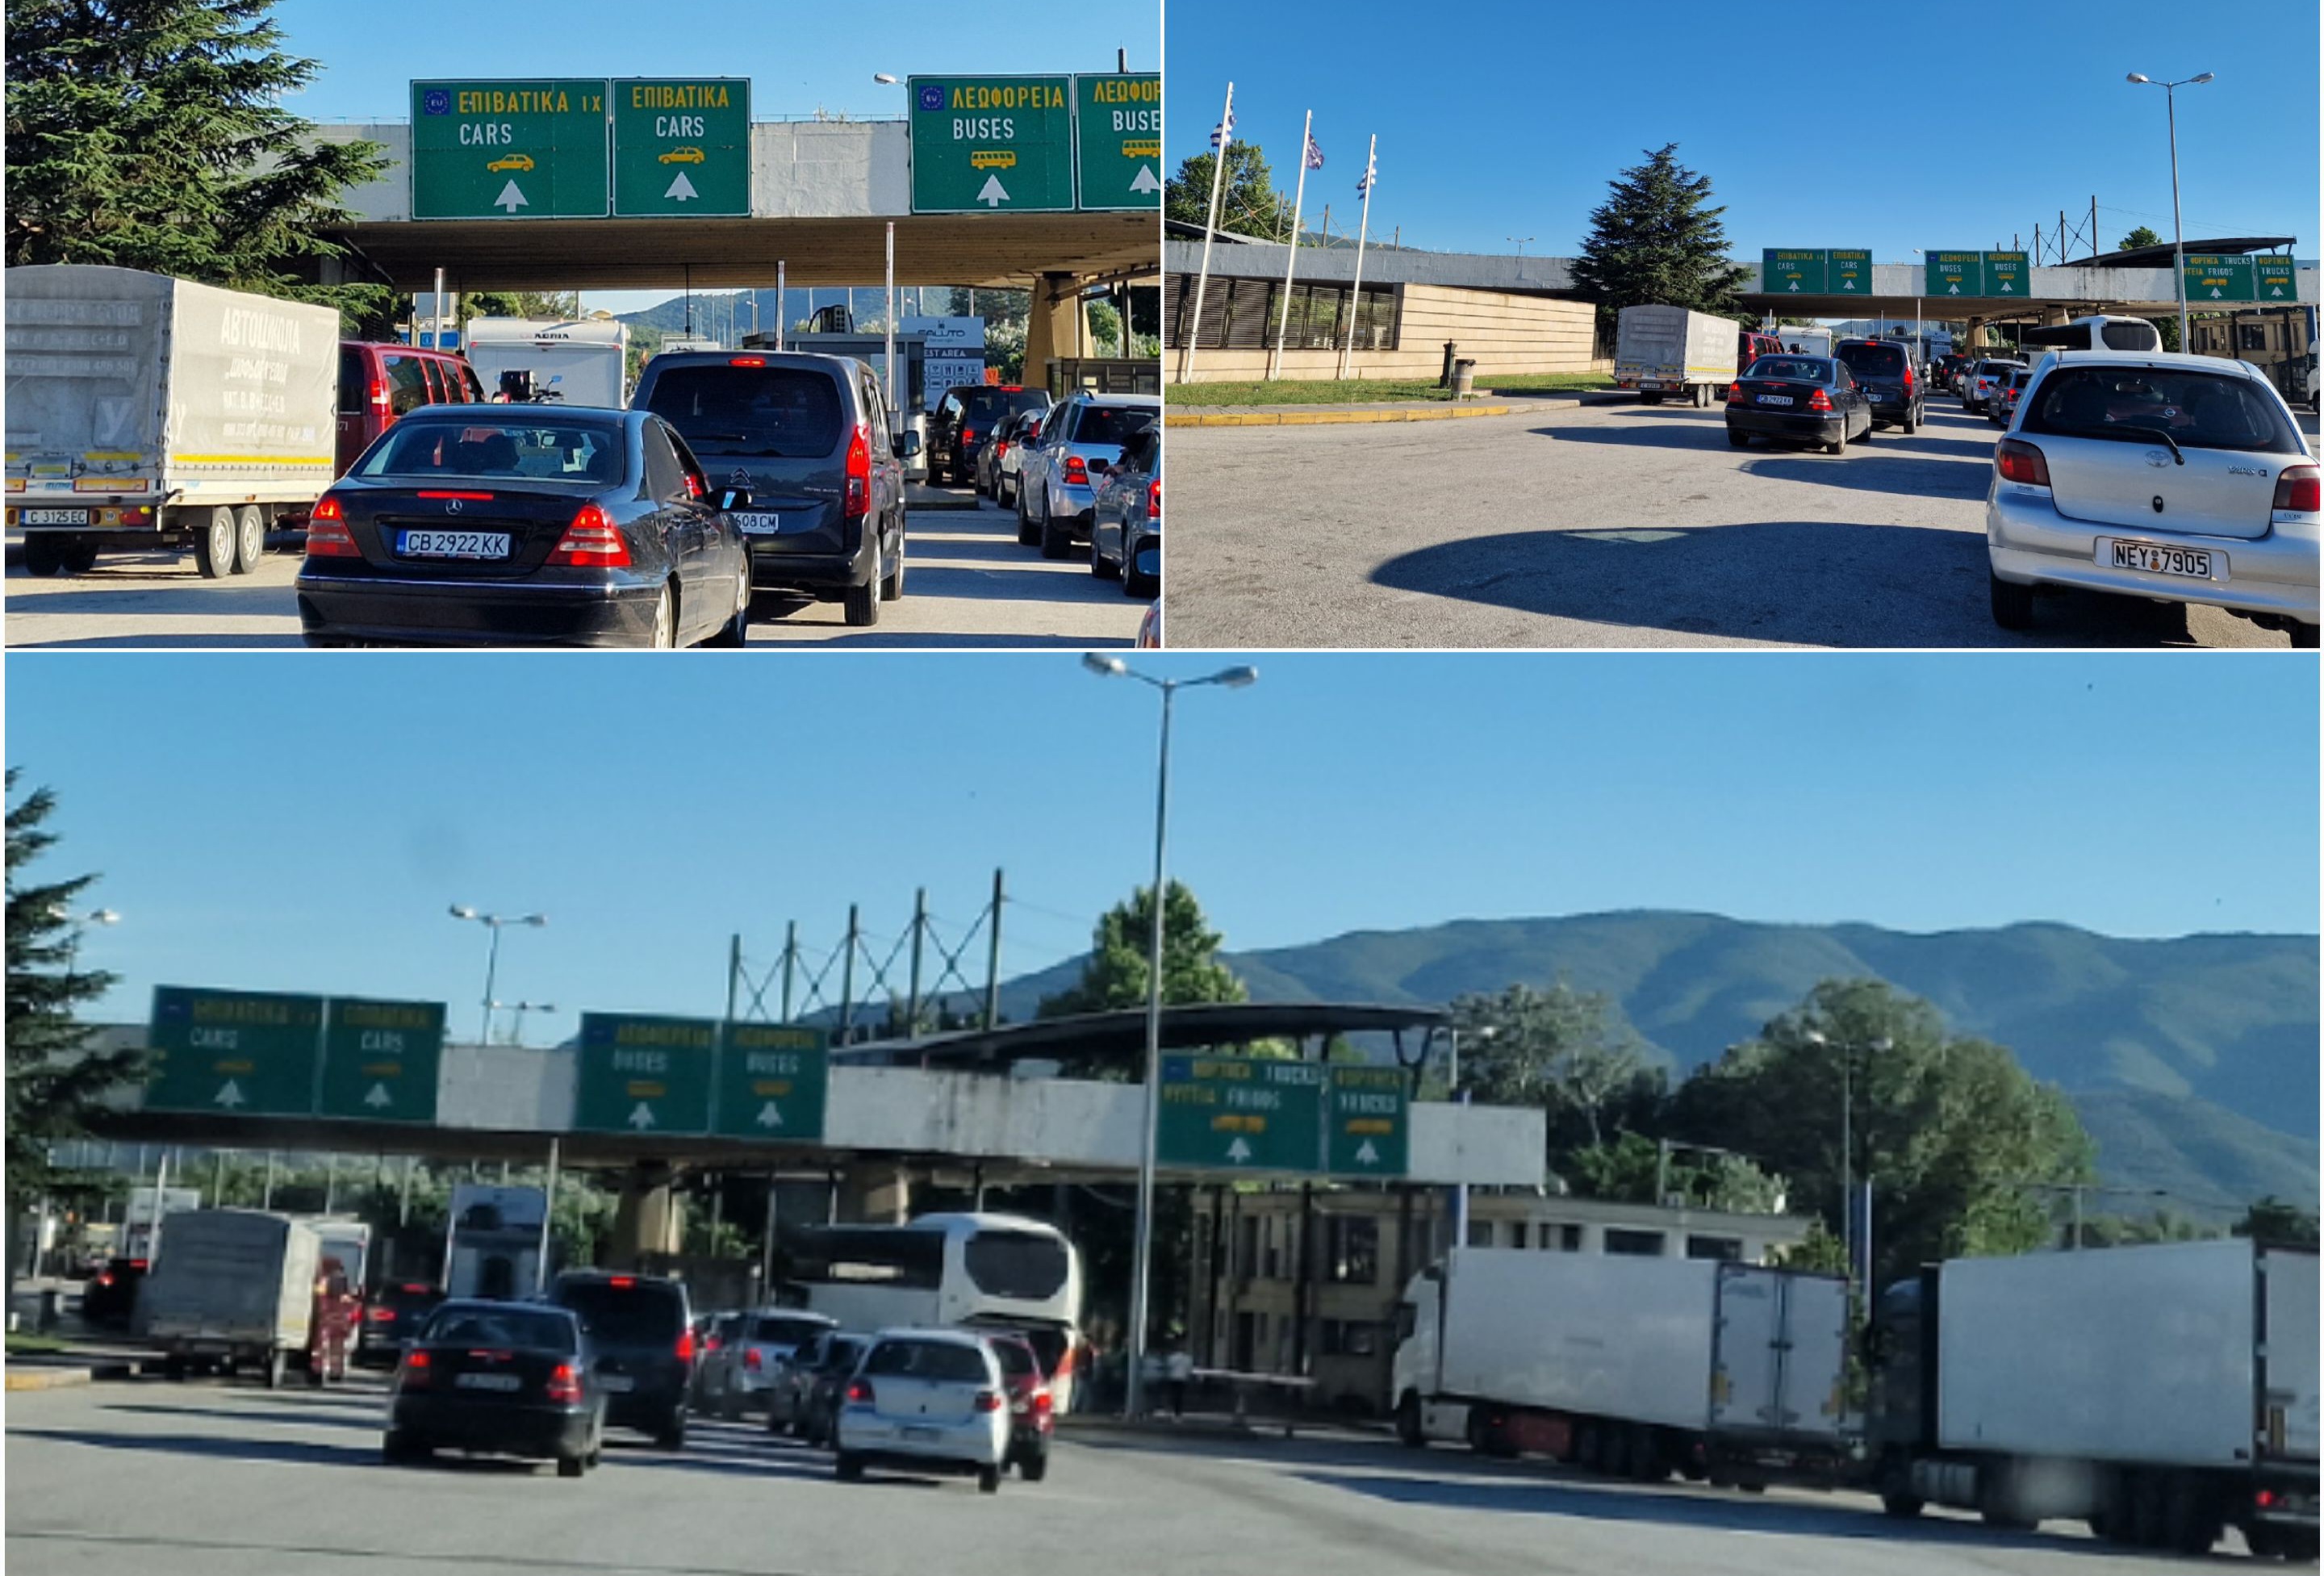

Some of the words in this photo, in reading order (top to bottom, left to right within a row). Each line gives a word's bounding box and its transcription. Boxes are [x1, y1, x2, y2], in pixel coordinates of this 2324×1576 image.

[458, 91, 569, 113] ΕΠΙΒΑΤΙΚΑ
[633, 86, 729, 107] ΕΠΙΒΑΤΙΚΑ
[952, 86, 1064, 109] ΛΕΩΦΟΡΕΙΑ
[459, 123, 512, 145] CARS
[656, 115, 704, 137] CARS
[953, 118, 1014, 140] BUSES
[1778, 262, 1795, 270] CARS
[1940, 265, 1962, 273] BUSES
[1995, 263, 2017, 271] BUSES
[2225, 257, 2251, 265] TRUCKS
[2208, 268, 2234, 276] FRIGOS
[2261, 267, 2289, 275] TRUCKS
[221, 307, 301, 355] АВТОШКОЛА
[924, 349, 938, 357] EST
[941, 349, 967, 357] AREA
[43, 511, 69, 523] 3125
[71, 511, 85, 523] EC
[735, 514, 758, 527] 608
[759, 515, 776, 528] CM
[408, 533, 432, 552] CB
[434, 534, 479, 553] 2922
[482, 535, 505, 554] KK
[2115, 545, 2148, 566] NEY
[2162, 550, 2208, 575] 7905
